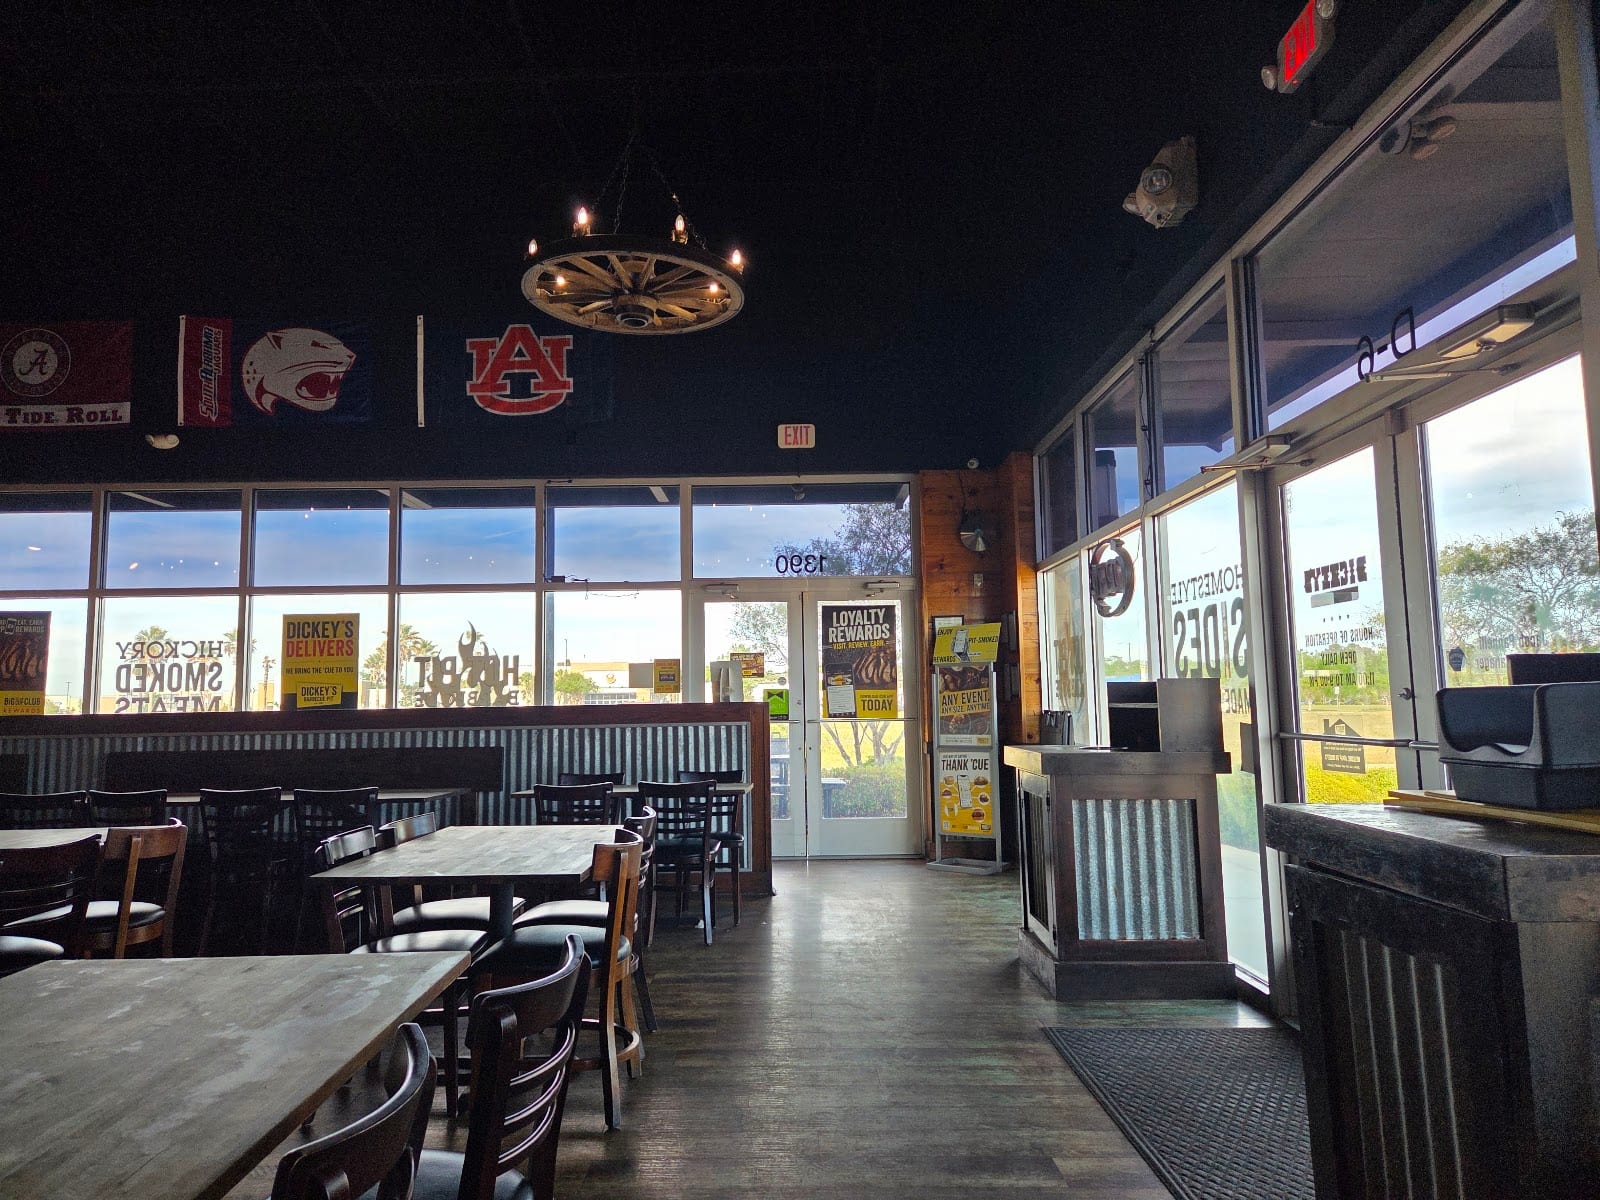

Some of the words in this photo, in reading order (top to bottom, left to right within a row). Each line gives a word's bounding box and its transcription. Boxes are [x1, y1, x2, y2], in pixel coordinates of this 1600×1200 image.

[784, 425, 811, 446] EXIT
[833, 608, 886, 628] LOYALTY
[286, 620, 354, 639] DICKEY'S
[828, 624, 890, 643] REWARDS
[286, 639, 354, 657] DELIVERS
[301, 685, 337, 697] DICKEY'S
[941, 693, 958, 706] ANY
[861, 699, 893, 711] TODAY
[941, 759, 969, 771] THANK
[970, 758, 989, 771] 'CUE
